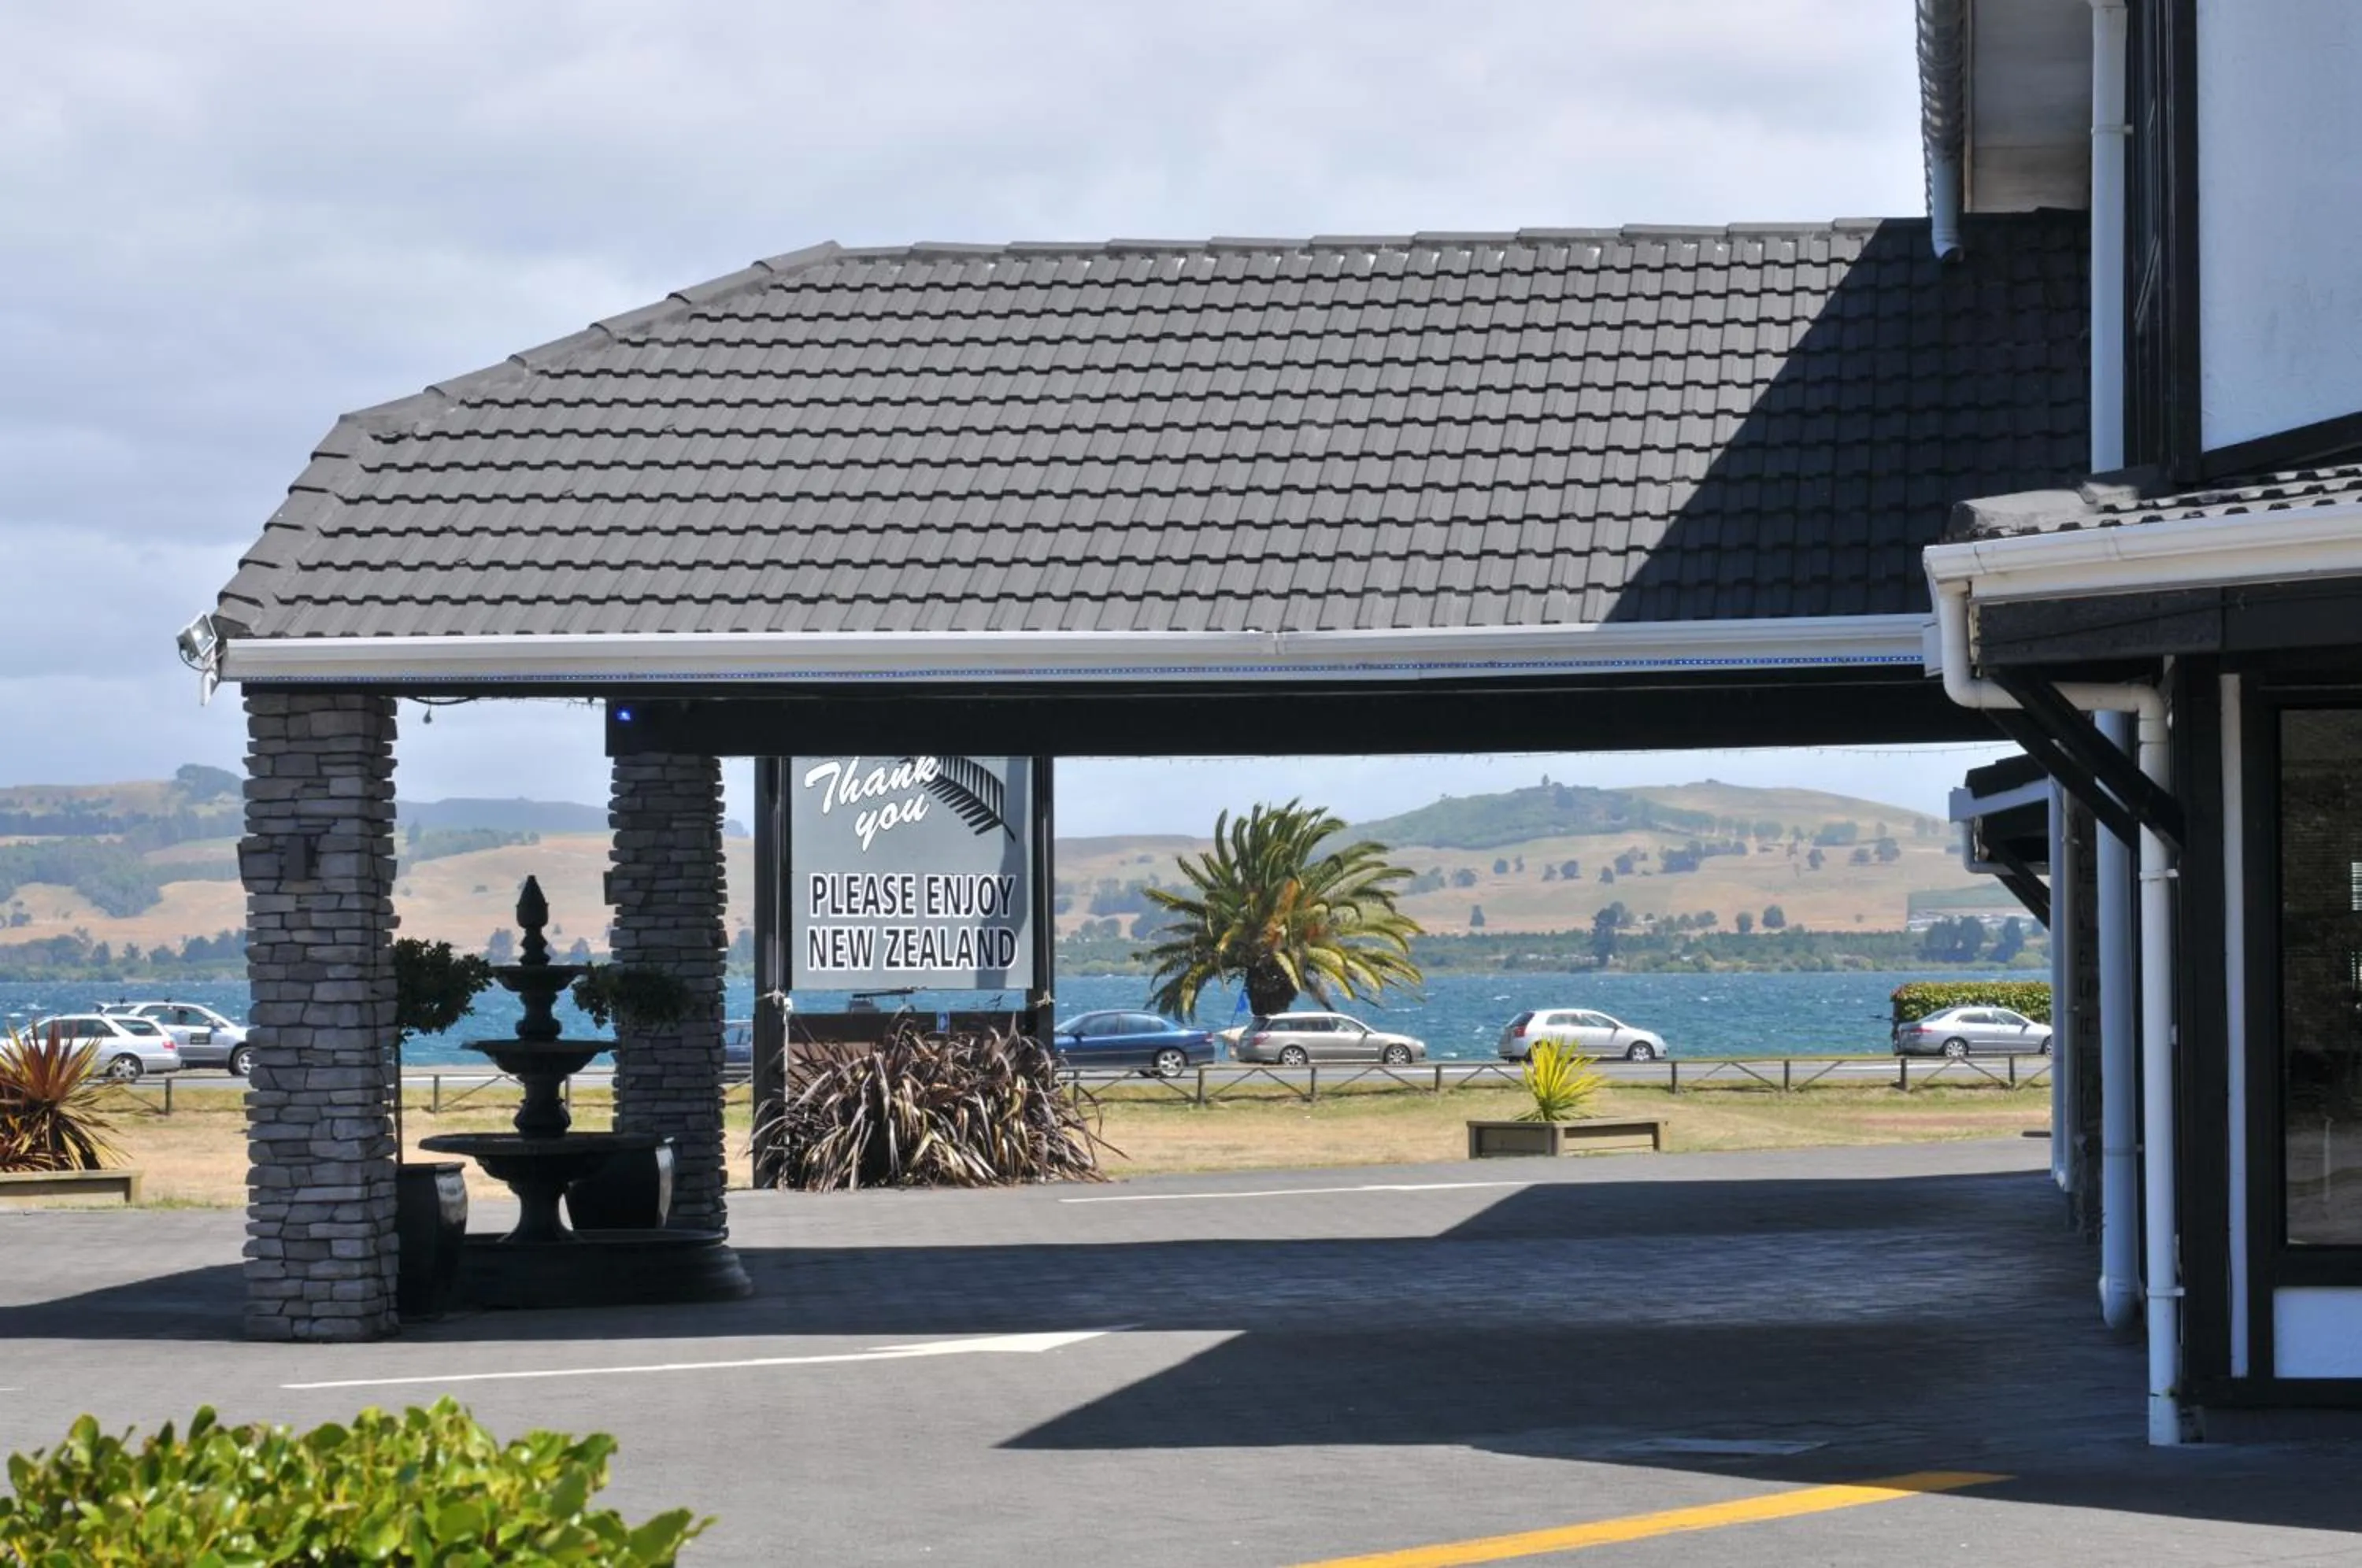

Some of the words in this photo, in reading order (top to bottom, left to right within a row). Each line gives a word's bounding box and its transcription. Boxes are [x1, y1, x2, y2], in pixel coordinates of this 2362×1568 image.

[805, 756, 941, 814] Thank
[855, 793, 930, 851] you
[809, 874, 916, 918] PLEASE
[925, 874, 1016, 919] ENJOY
[807, 926, 877, 971] NEW
[883, 926, 1017, 971] ZEALAND
